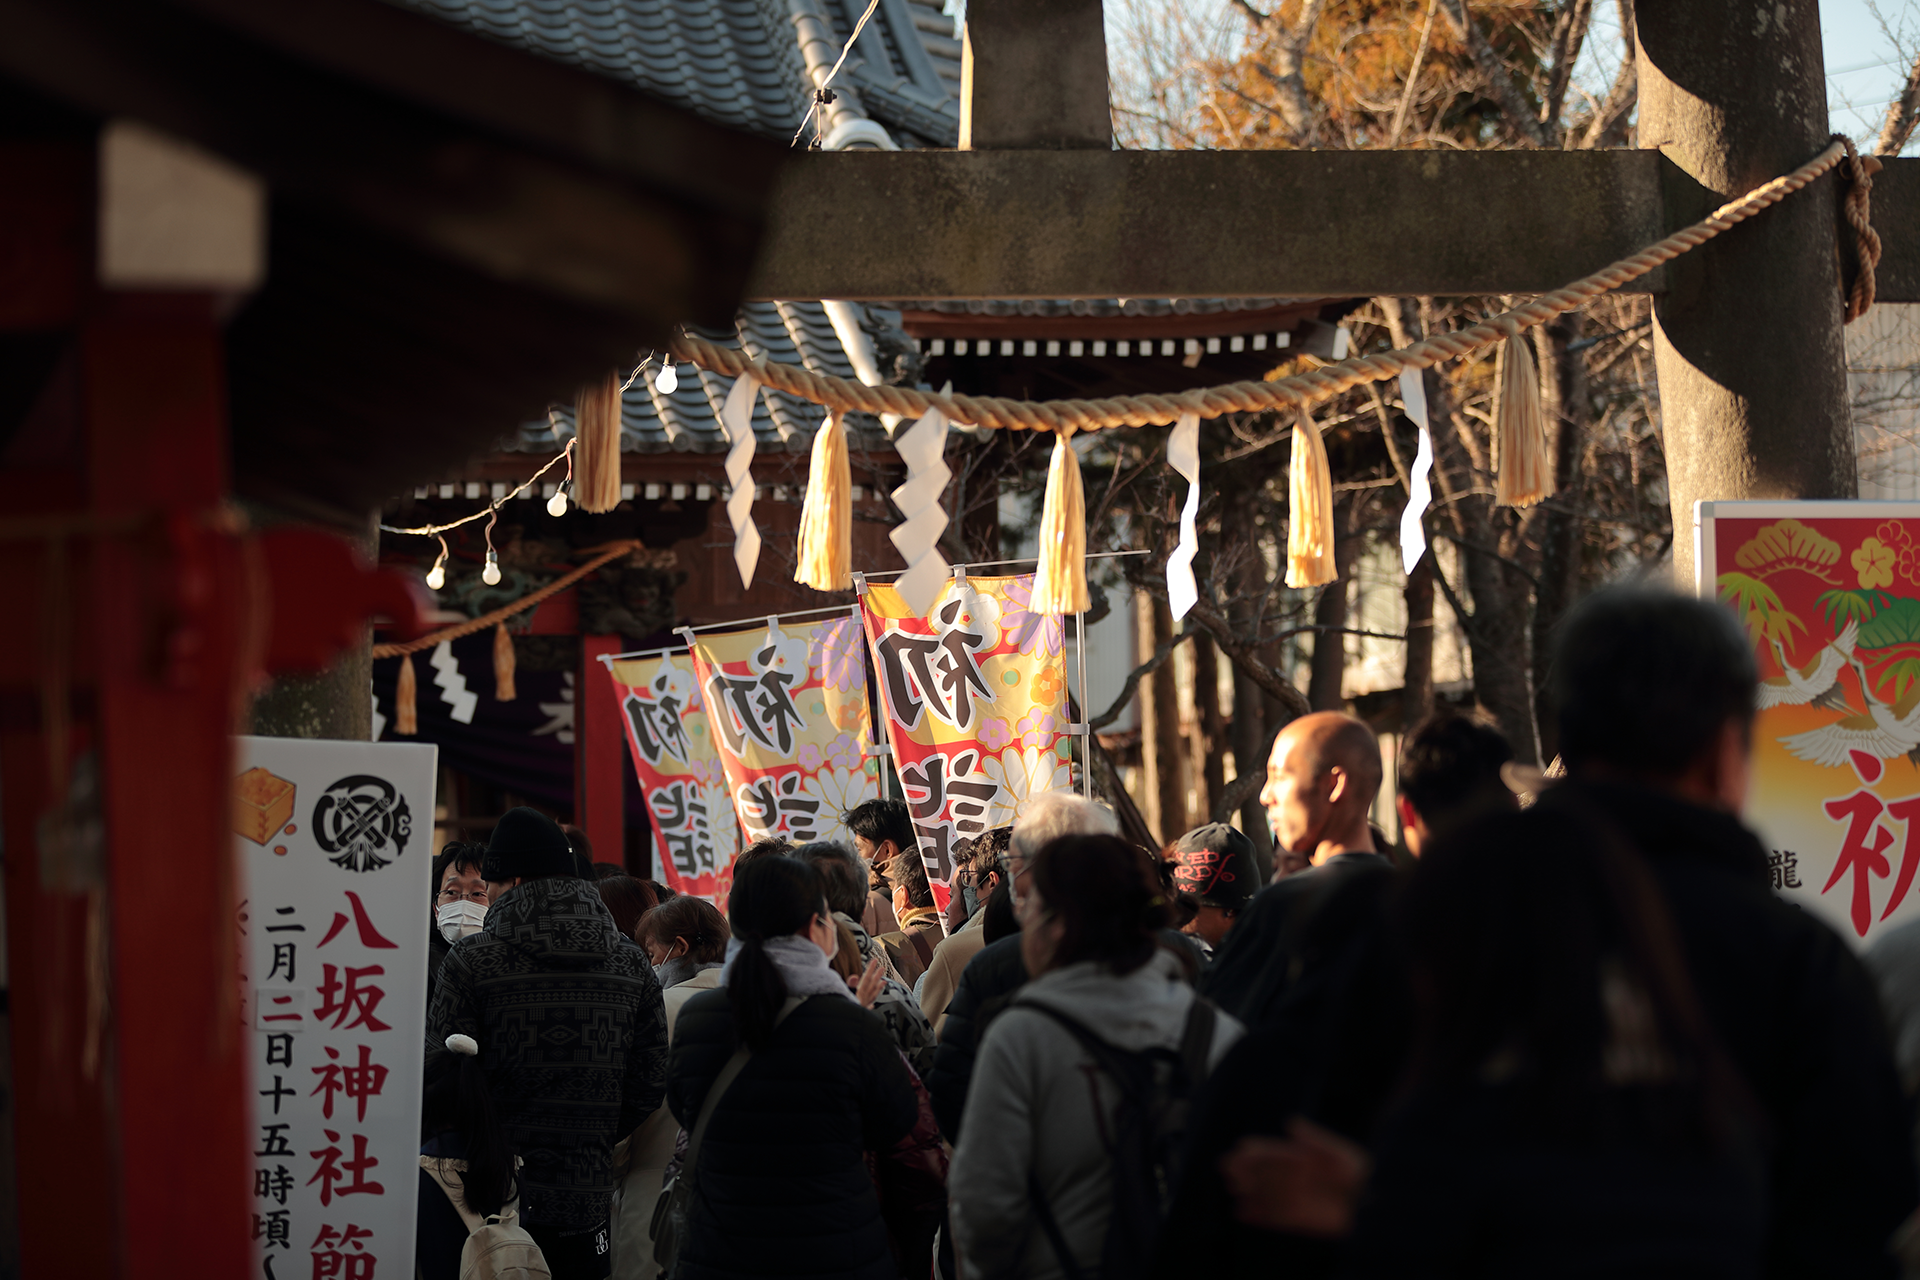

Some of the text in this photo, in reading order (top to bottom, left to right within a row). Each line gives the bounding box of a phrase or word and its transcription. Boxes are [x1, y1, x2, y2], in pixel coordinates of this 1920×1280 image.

[1768, 849, 1802, 910] 龍
[306, 890, 400, 1280] 八坂神社節
